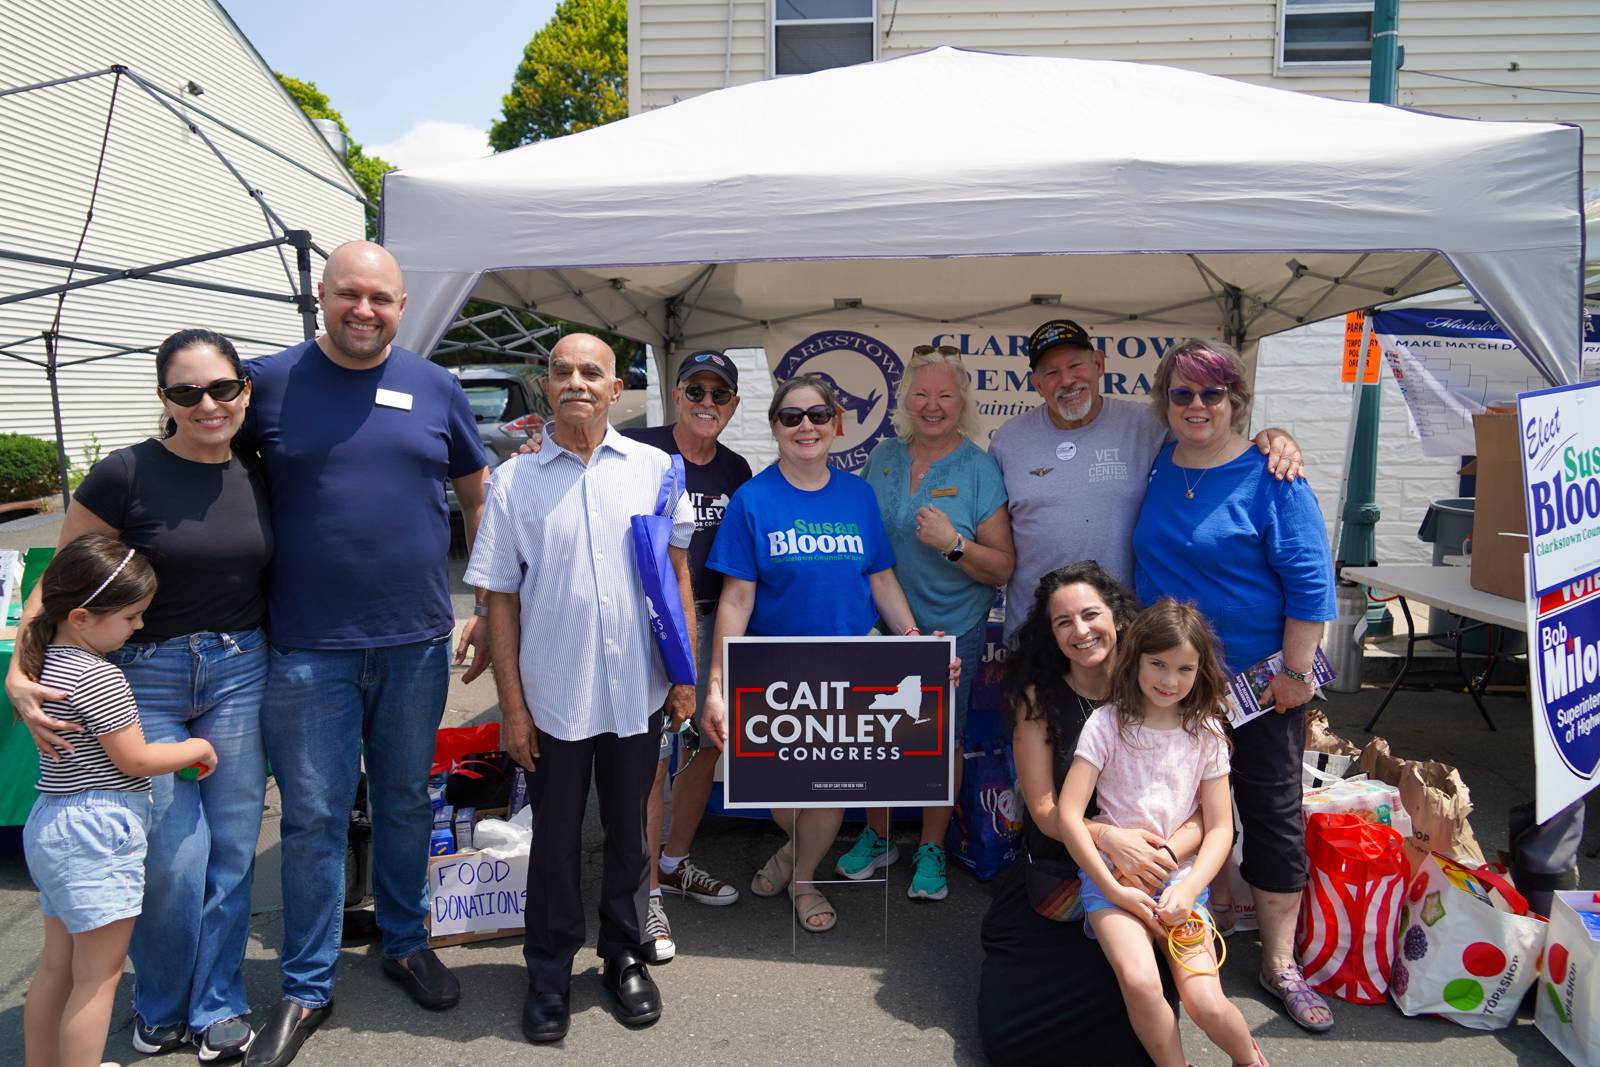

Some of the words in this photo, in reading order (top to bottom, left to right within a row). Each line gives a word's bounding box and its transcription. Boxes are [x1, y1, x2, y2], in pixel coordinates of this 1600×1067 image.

[1346, 339, 1378, 348] TEMPORY
[1395, 340, 1442, 348] MAKE
[1445, 341, 1497, 350] MATCH
[1502, 343, 1521, 351] DA
[1526, 406, 1561, 461] Elect
[1095, 448, 1120, 462] VET
[1088, 464, 1128, 478] CENTER
[794, 519, 859, 535] Susan
[768, 528, 864, 556] Bloom
[1535, 532, 1582, 557] Clarkstown
[1542, 621, 1567, 651] Bob
[765, 681, 850, 710] CAIT
[745, 714, 902, 744] CONLEY
[1565, 722, 1575, 744] of
[778, 746, 900, 761] CONGRESS
[438, 860, 510, 886] FOOD
